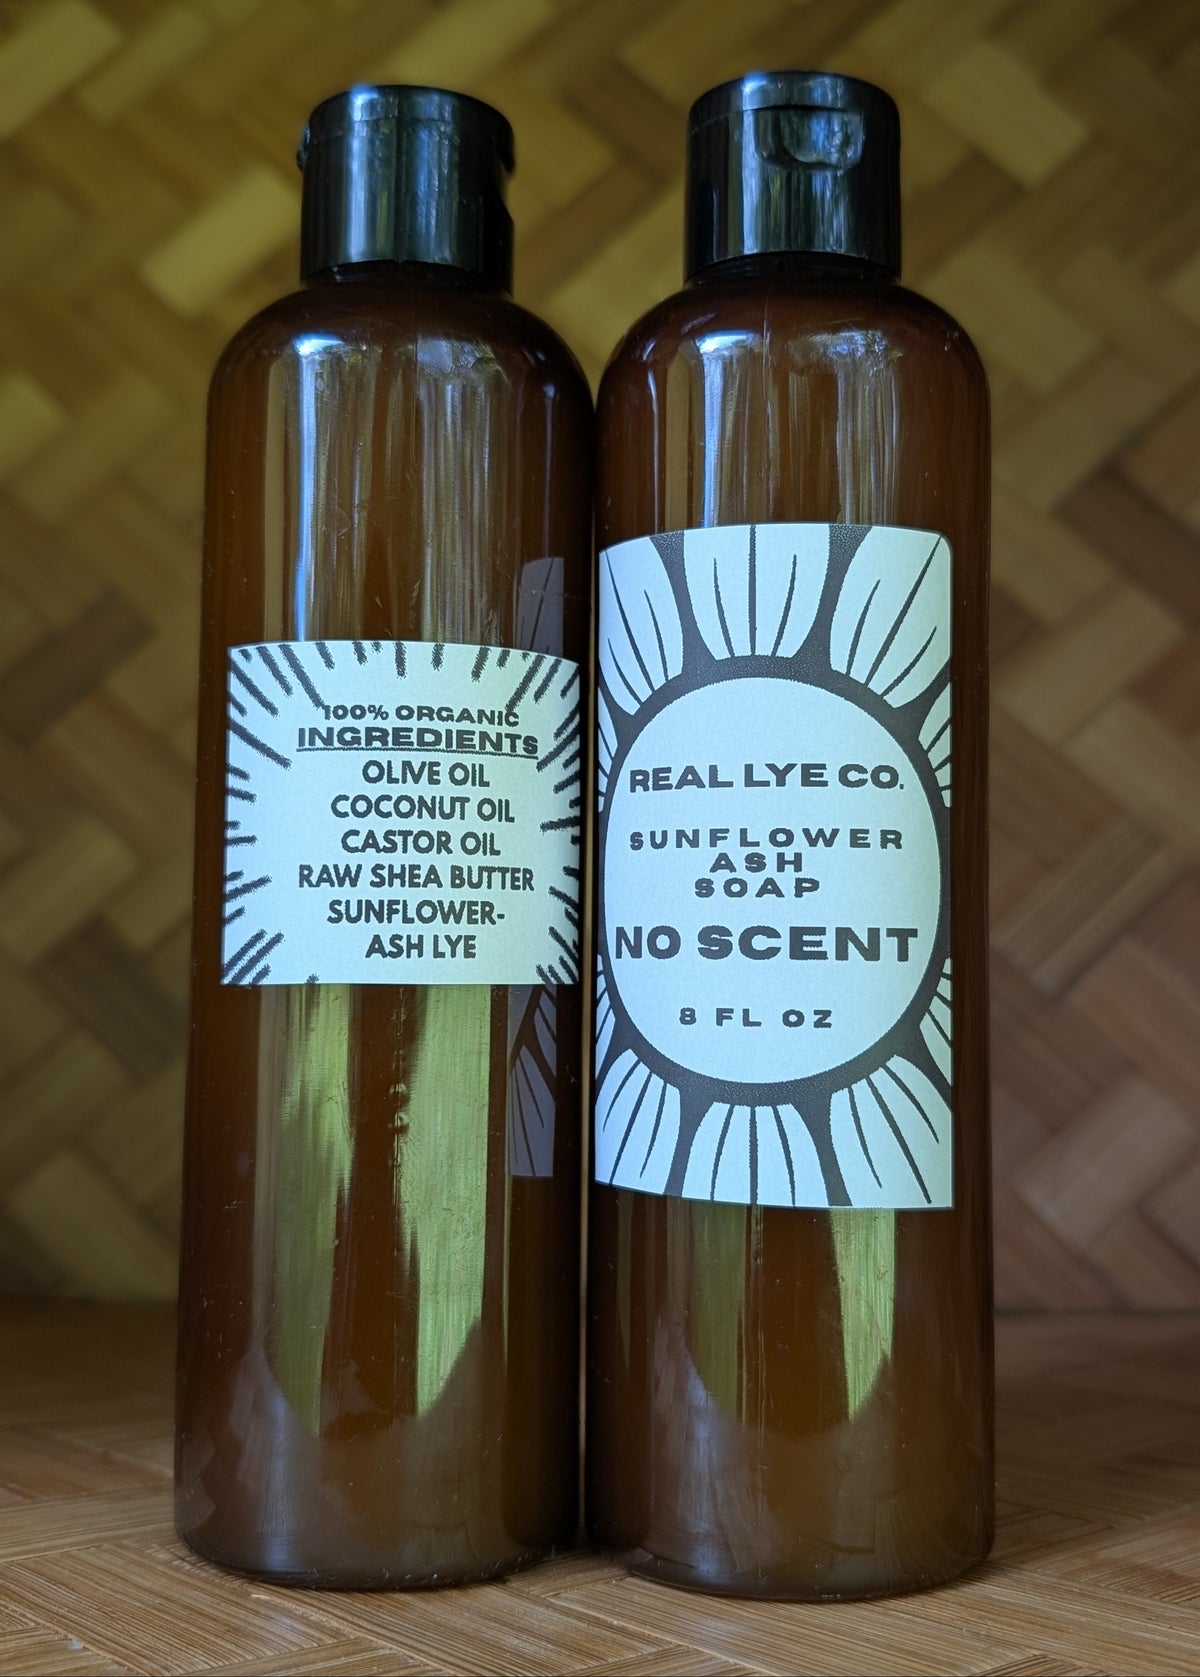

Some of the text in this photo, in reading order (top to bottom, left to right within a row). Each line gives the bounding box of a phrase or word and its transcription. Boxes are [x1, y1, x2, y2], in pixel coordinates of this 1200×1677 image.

[324, 704, 520, 727] 100% ORGANIC
[298, 727, 539, 755] INGREDIENTS
[362, 760, 491, 788] OLIVE OIL
[629, 763, 905, 793] REAL LYE CO.
[330, 794, 516, 823] COCONUT OIL
[340, 829, 502, 857] CASTOR OIL
[629, 827, 903, 850] SUNFLOWER
[709, 852, 803, 874] ASH
[298, 863, 535, 892] RAW SHEA BUTTER
[694, 877, 820, 899] SOAP
[326, 899, 506, 925] SUNFLOWER-
[364, 934, 477, 959] ASH LYE
[615, 924, 919, 963] NO SCENT
[678, 1007, 833, 1029] 8 FL OZ
